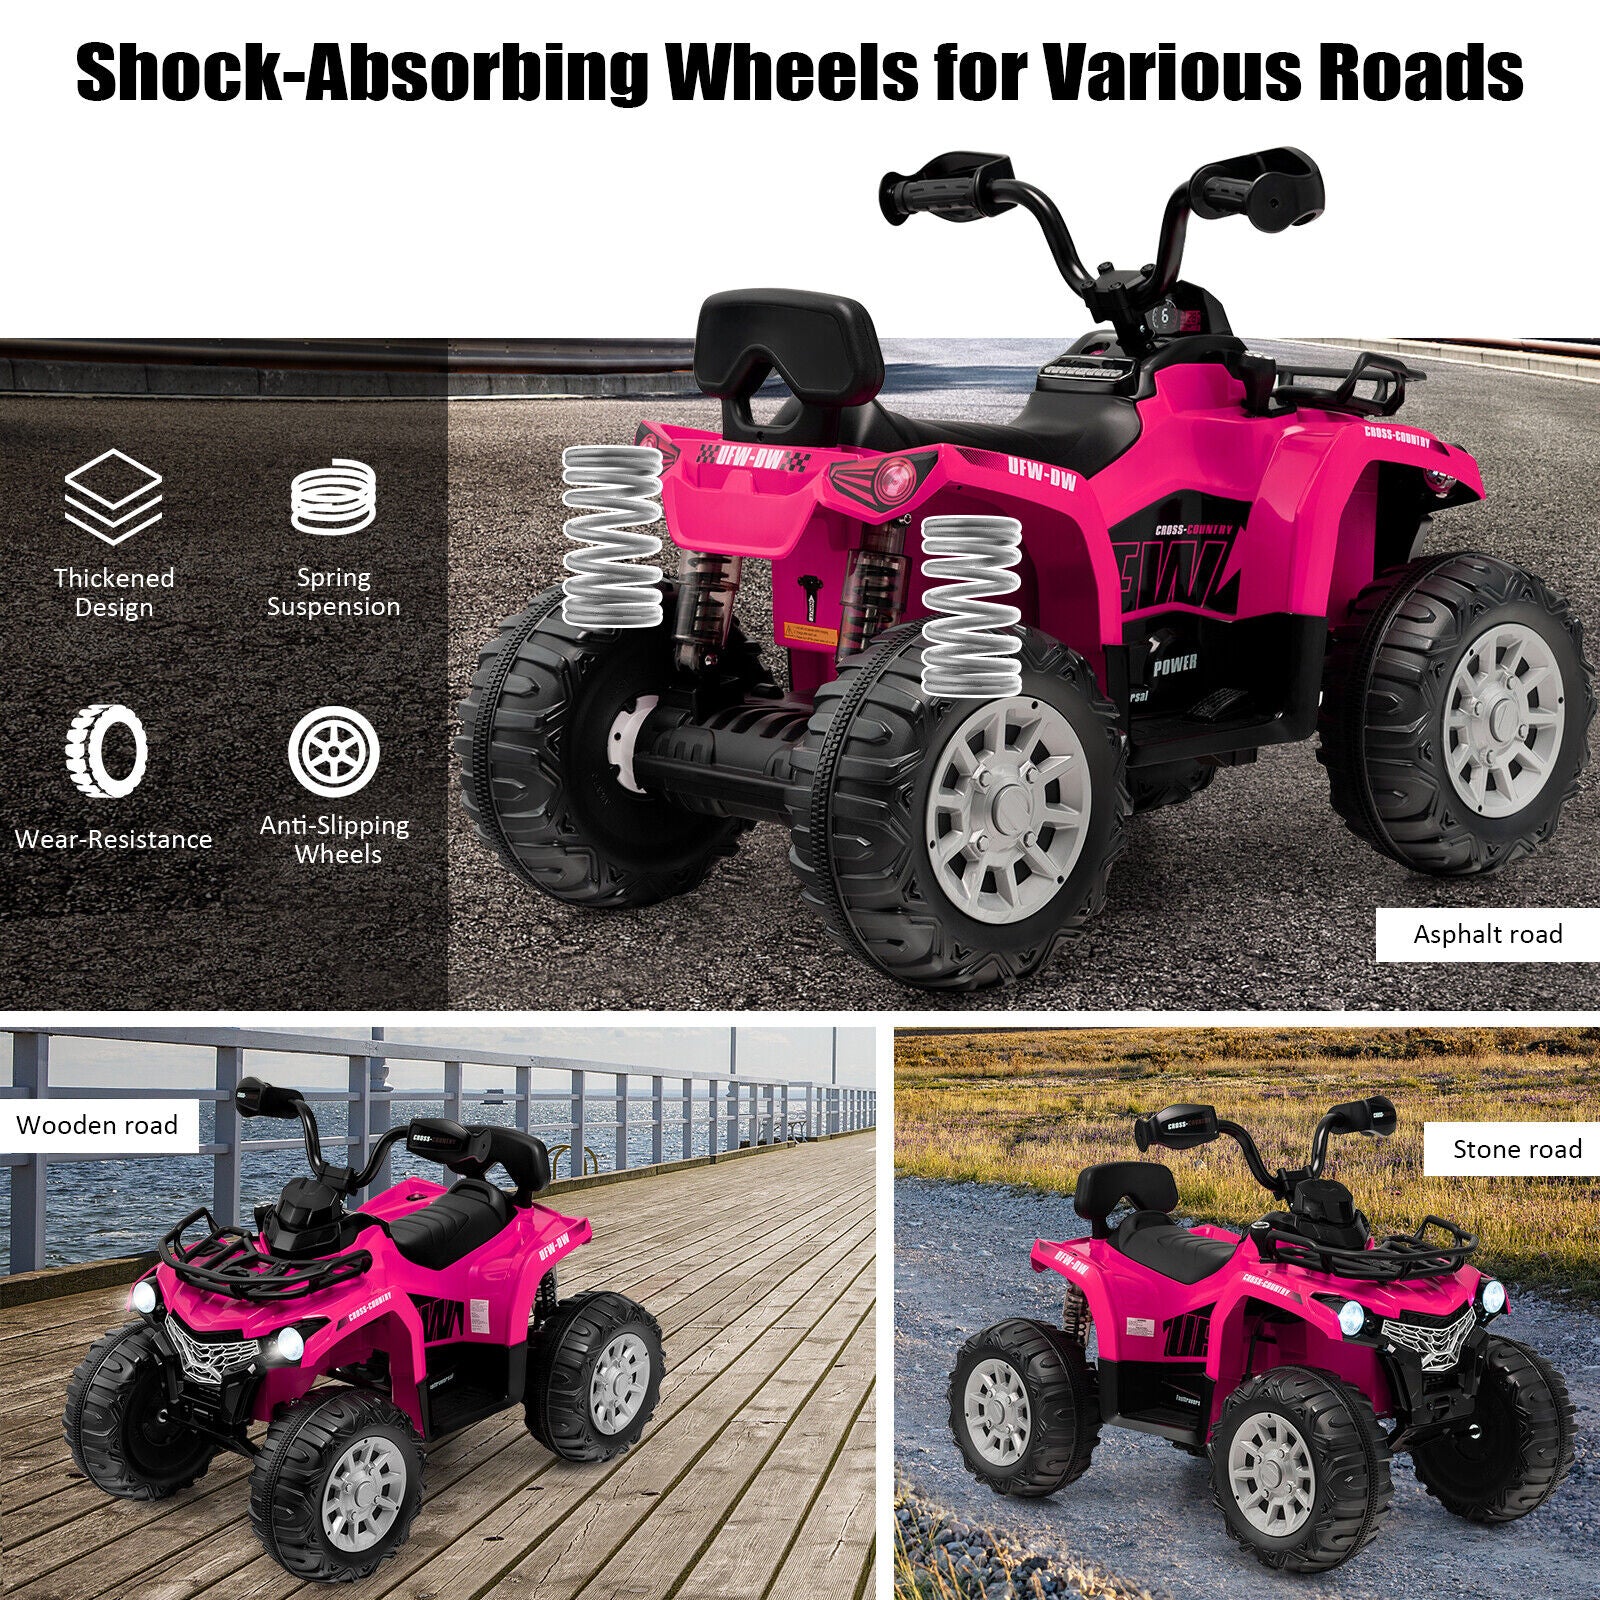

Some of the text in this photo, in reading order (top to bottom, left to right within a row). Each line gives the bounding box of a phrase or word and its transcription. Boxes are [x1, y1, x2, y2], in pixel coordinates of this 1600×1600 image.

[1364, 426, 1430, 449] CROSS-COUNTRY
[716, 445, 785, 470] UFW-DW
[1008, 456, 1077, 493] UFW-DW
[1155, 524, 1233, 536] CROSS-COUNTRY
[1153, 653, 1198, 677] POWER
[1242, 1273, 1291, 1297] CROSS-COUNTRY
[348, 1292, 392, 1322] CROSS-COUNTRY
